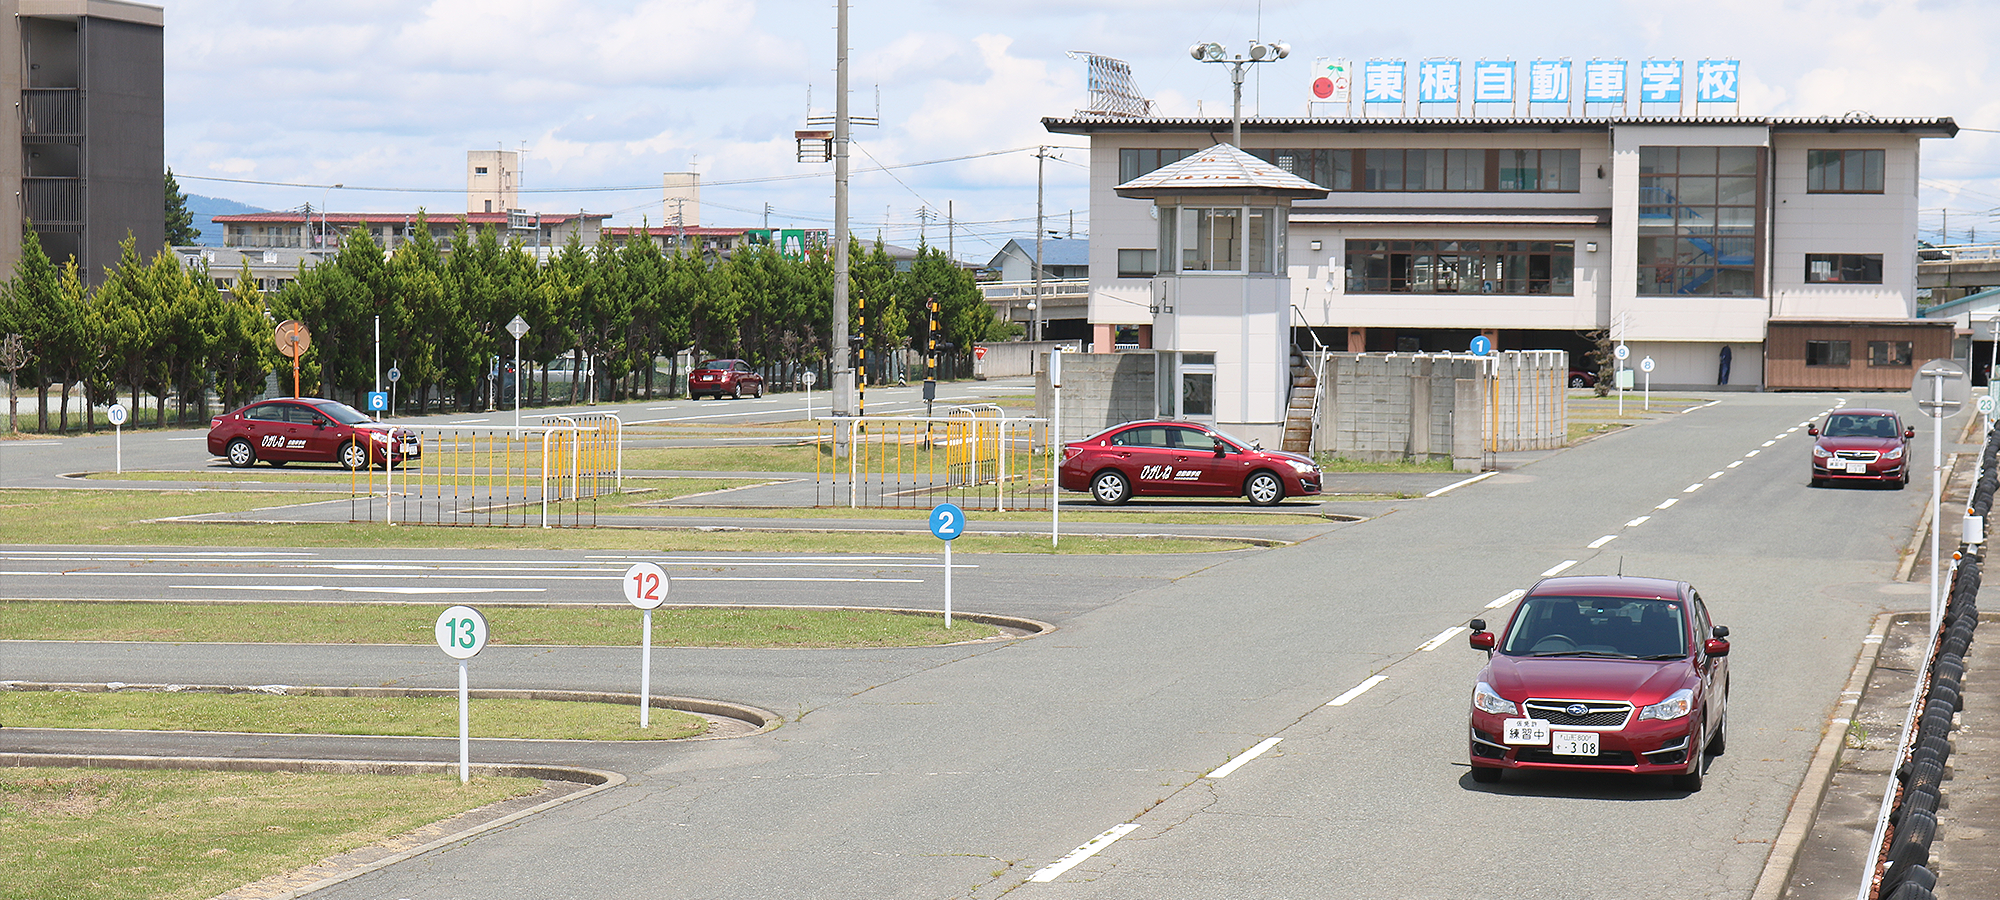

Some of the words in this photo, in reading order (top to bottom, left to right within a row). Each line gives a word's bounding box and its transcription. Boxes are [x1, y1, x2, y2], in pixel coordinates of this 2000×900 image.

[1366, 63, 1737, 100] 東根自動車学校
[1476, 340, 1484, 353] 1
[1619, 349, 1626, 358] 9
[1644, 361, 1651, 370] 8
[391, 371, 398, 380] P
[372, 394, 384, 409] 6
[1980, 400, 1992, 411] 23
[111, 409, 123, 421] 10
[1140, 464, 1173, 480] ひがしね
[938, 511, 955, 533] 2
[633, 572, 660, 600] 12
[445, 617, 476, 649] 13
[1509, 728, 1545, 740] 練習中
